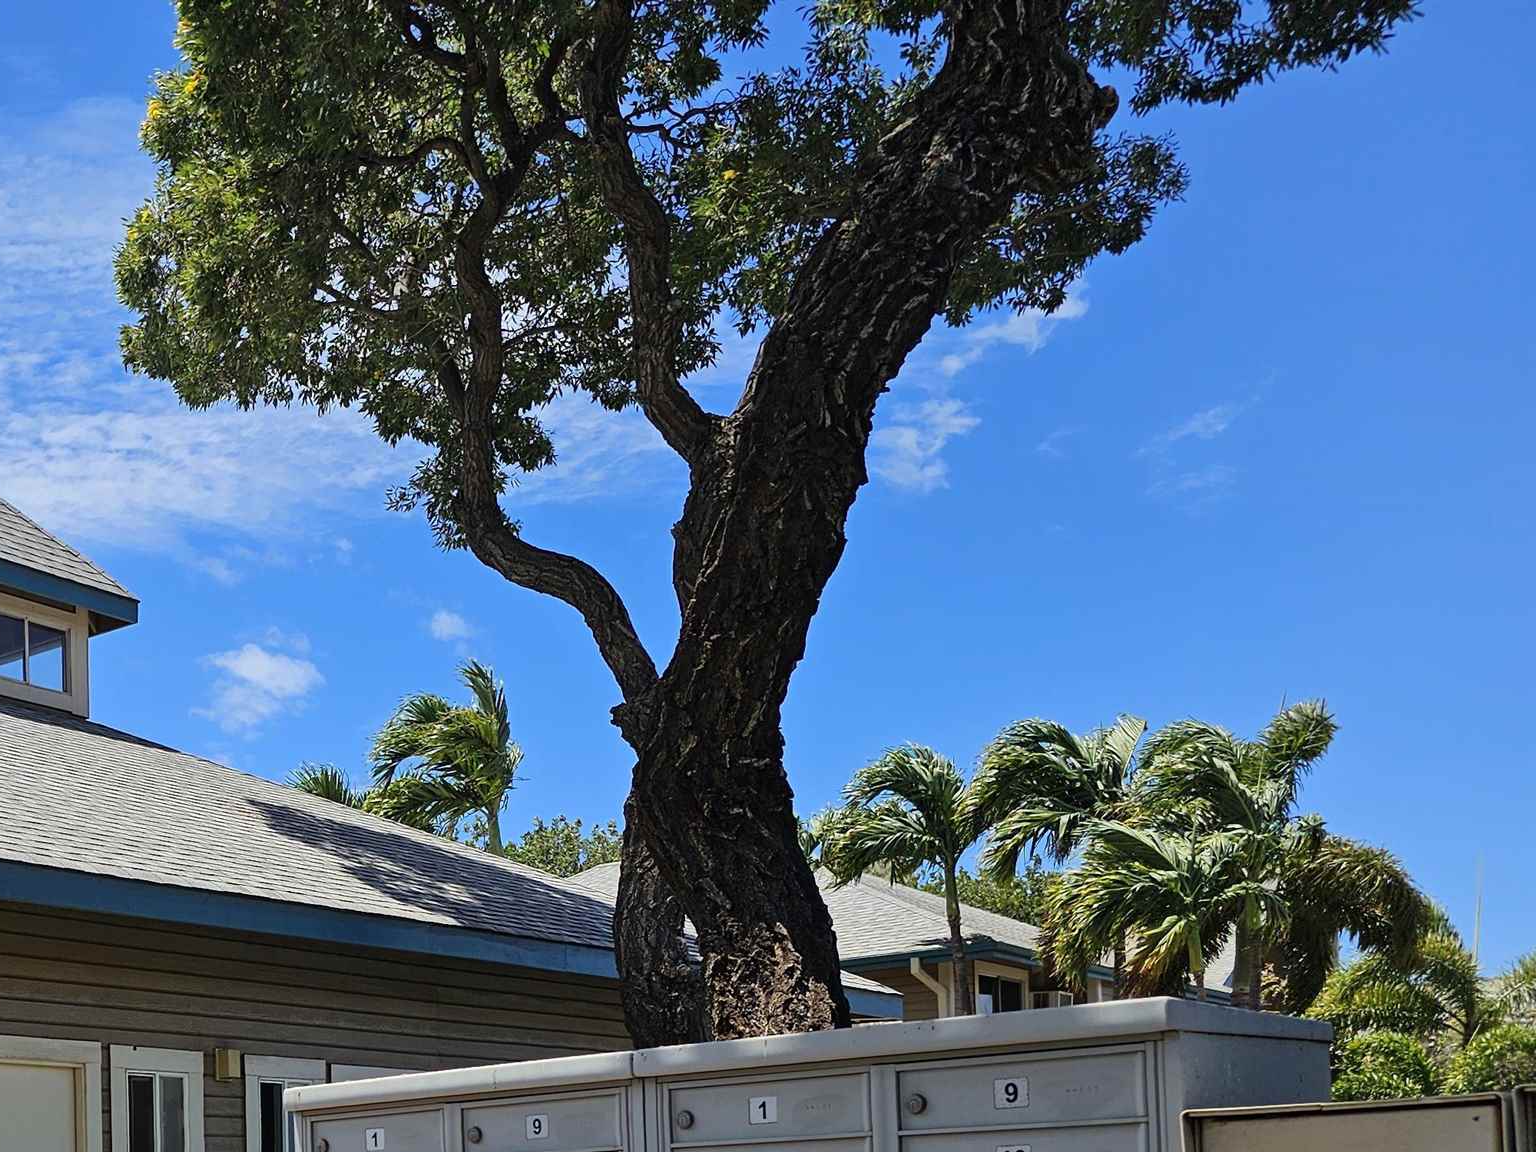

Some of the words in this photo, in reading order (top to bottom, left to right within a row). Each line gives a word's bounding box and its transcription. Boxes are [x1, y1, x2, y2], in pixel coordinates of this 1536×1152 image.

[1004, 1082, 1019, 1104] 9
[758, 1100, 767, 1120] 1
[532, 1118, 542, 1135] 9
[371, 1131, 378, 1148] 1
